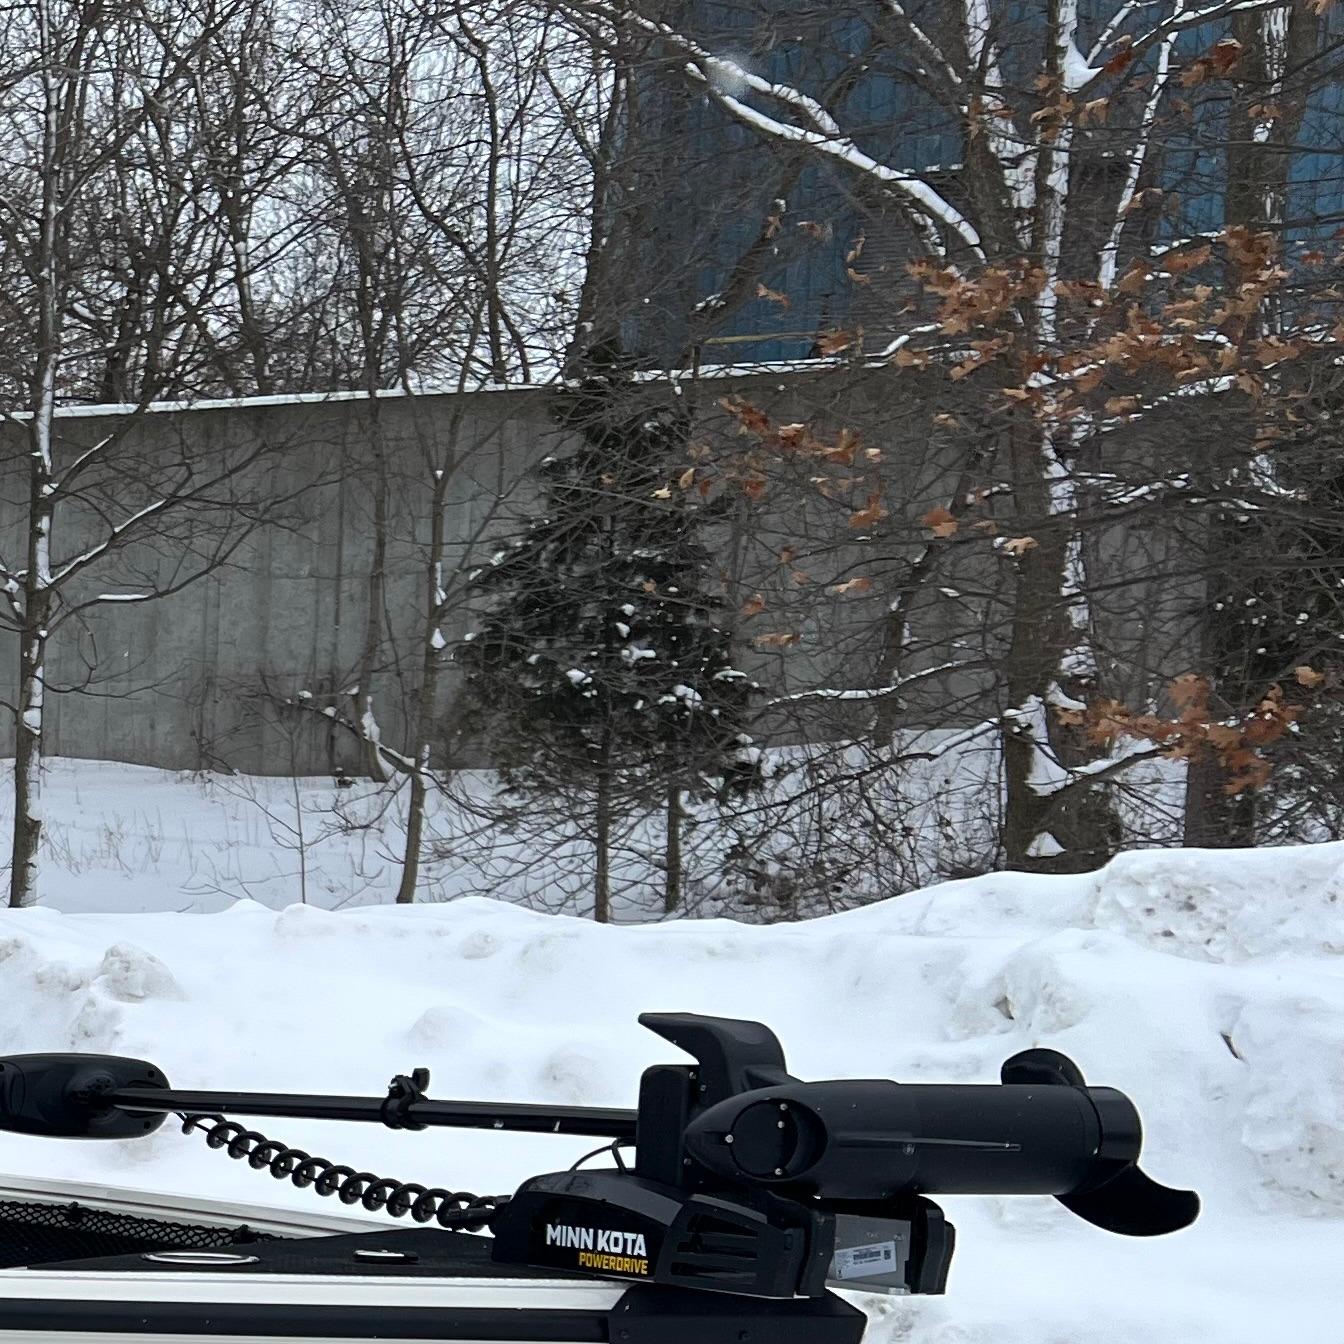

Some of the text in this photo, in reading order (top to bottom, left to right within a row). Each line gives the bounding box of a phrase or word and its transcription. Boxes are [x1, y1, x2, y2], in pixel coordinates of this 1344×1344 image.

[545, 1223, 648, 1257] MINN KOTA
[578, 1251, 649, 1275] POWERDRIVE
